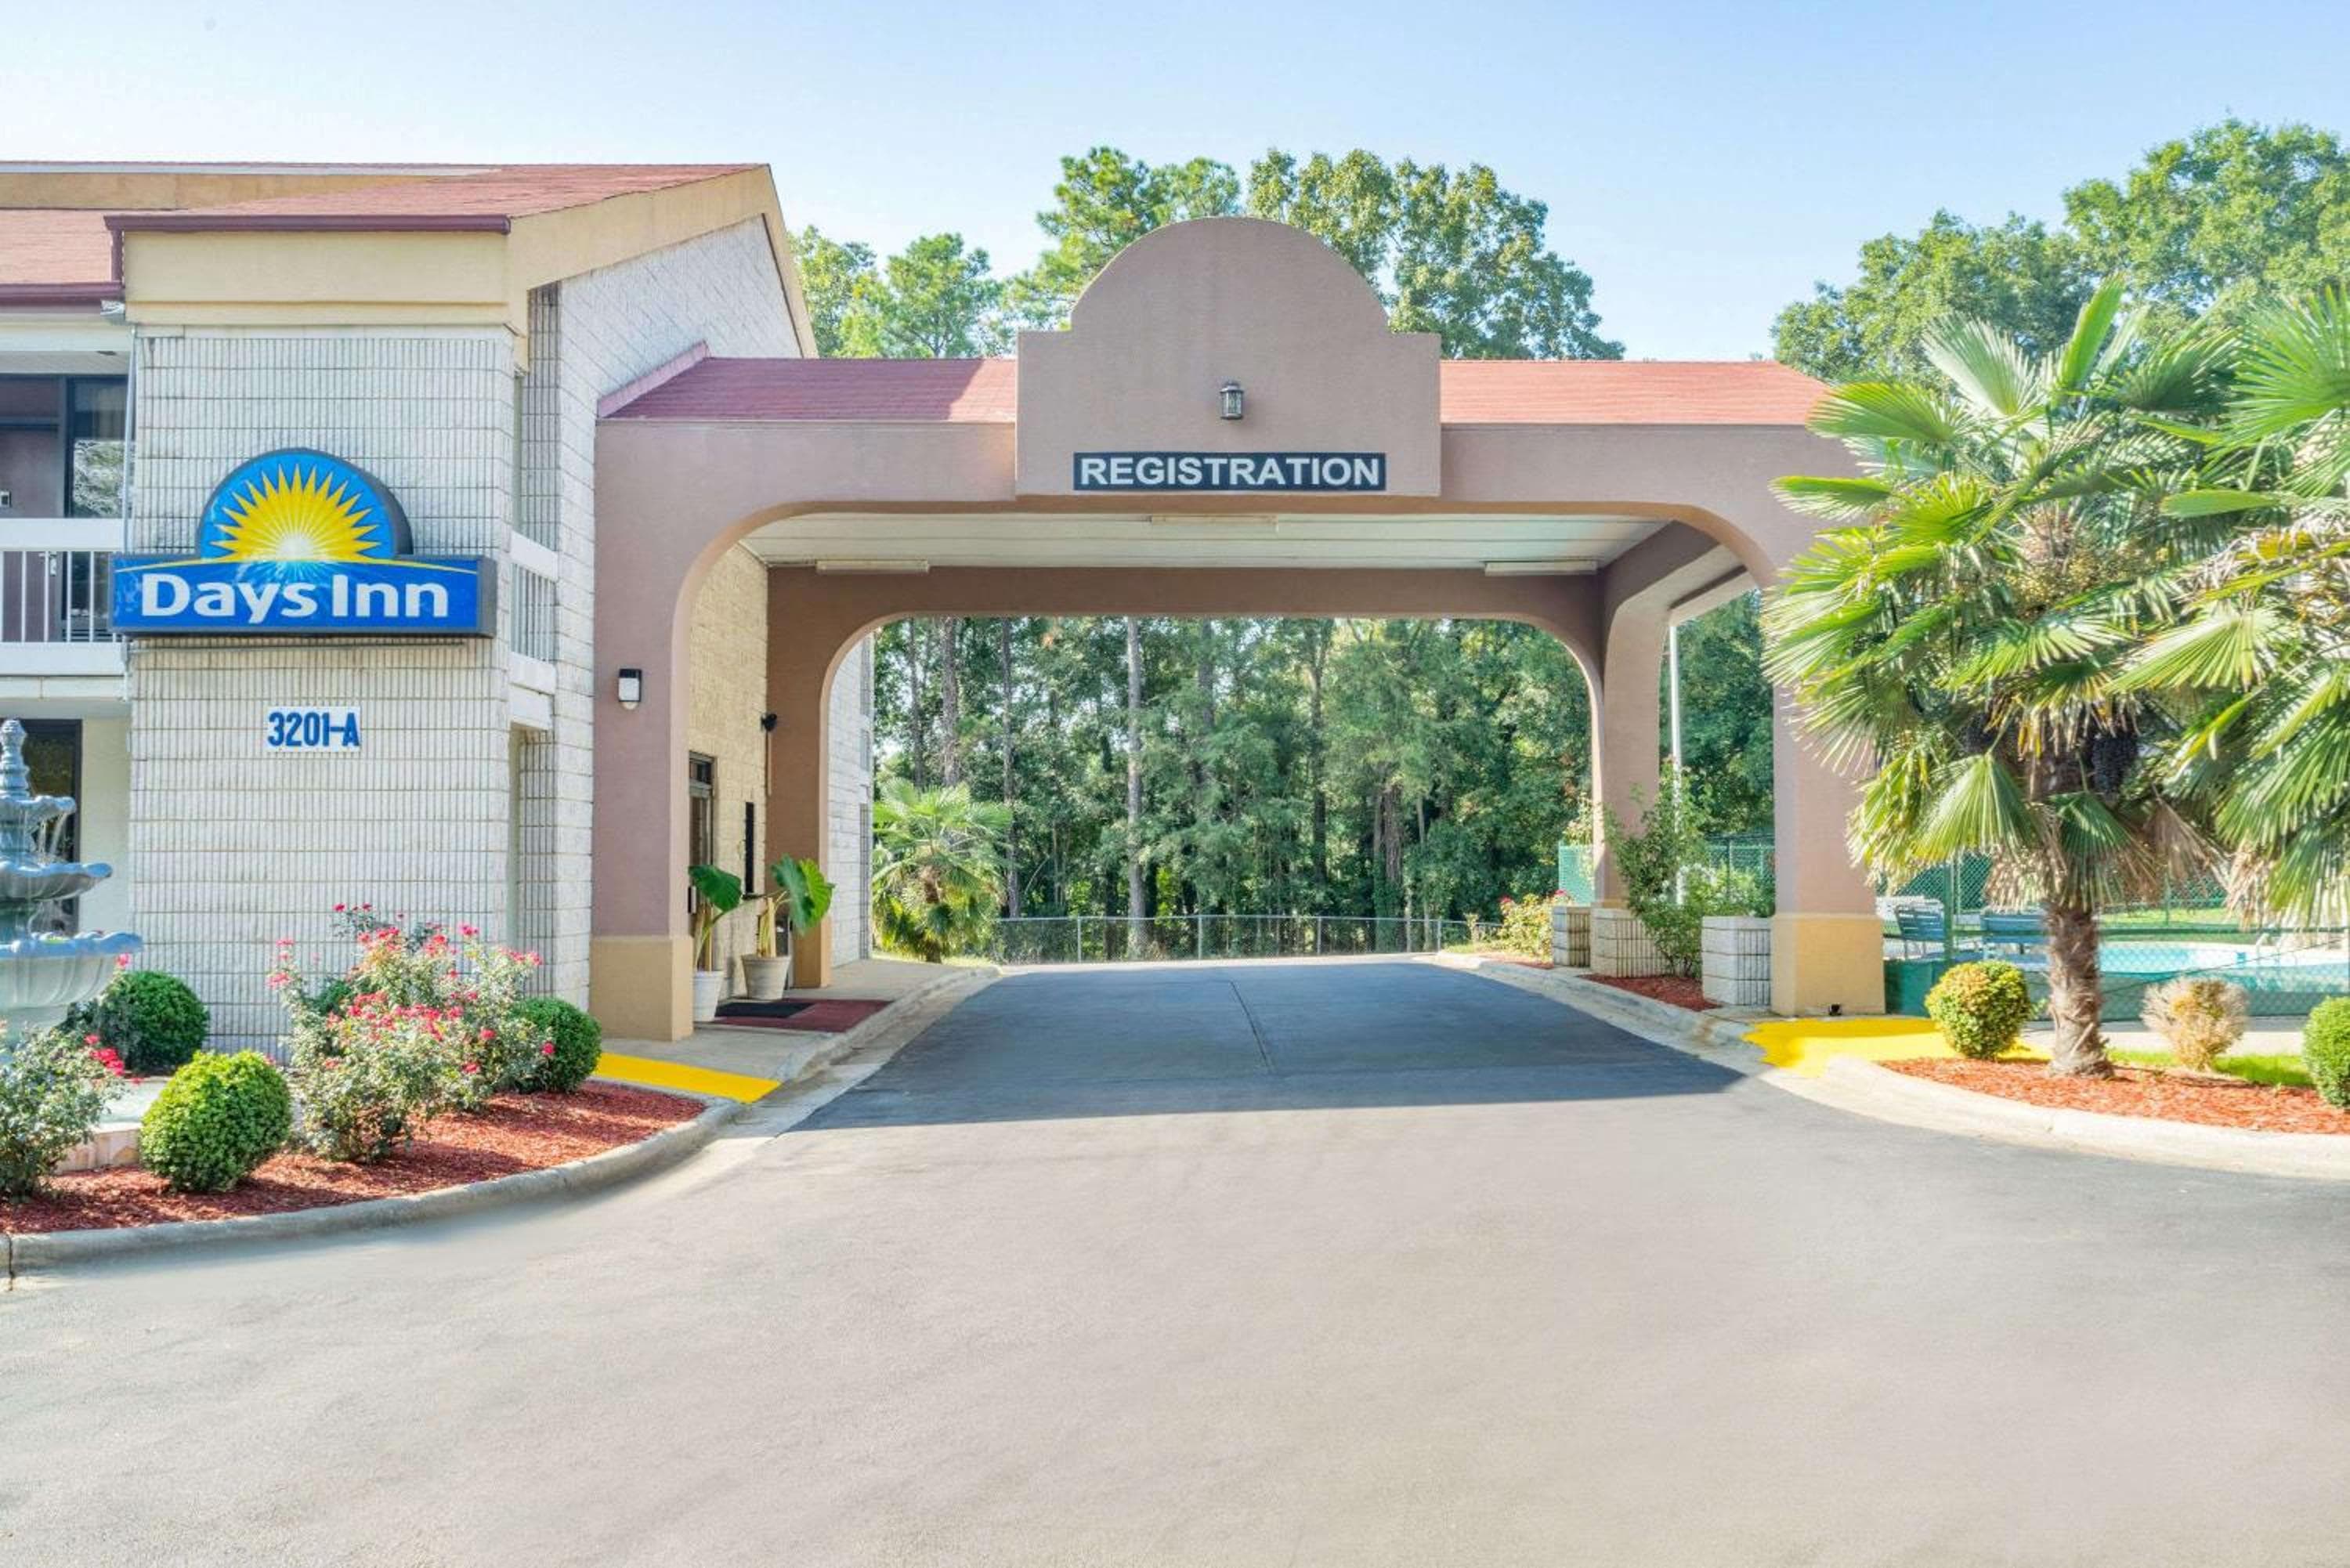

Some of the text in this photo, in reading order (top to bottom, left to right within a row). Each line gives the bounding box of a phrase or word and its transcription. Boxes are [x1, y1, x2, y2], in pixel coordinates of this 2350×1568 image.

[1080, 457, 1379, 486] REGISTRATION
[142, 573, 448, 623] Days Inn
[267, 711, 360, 747] 3201-A
